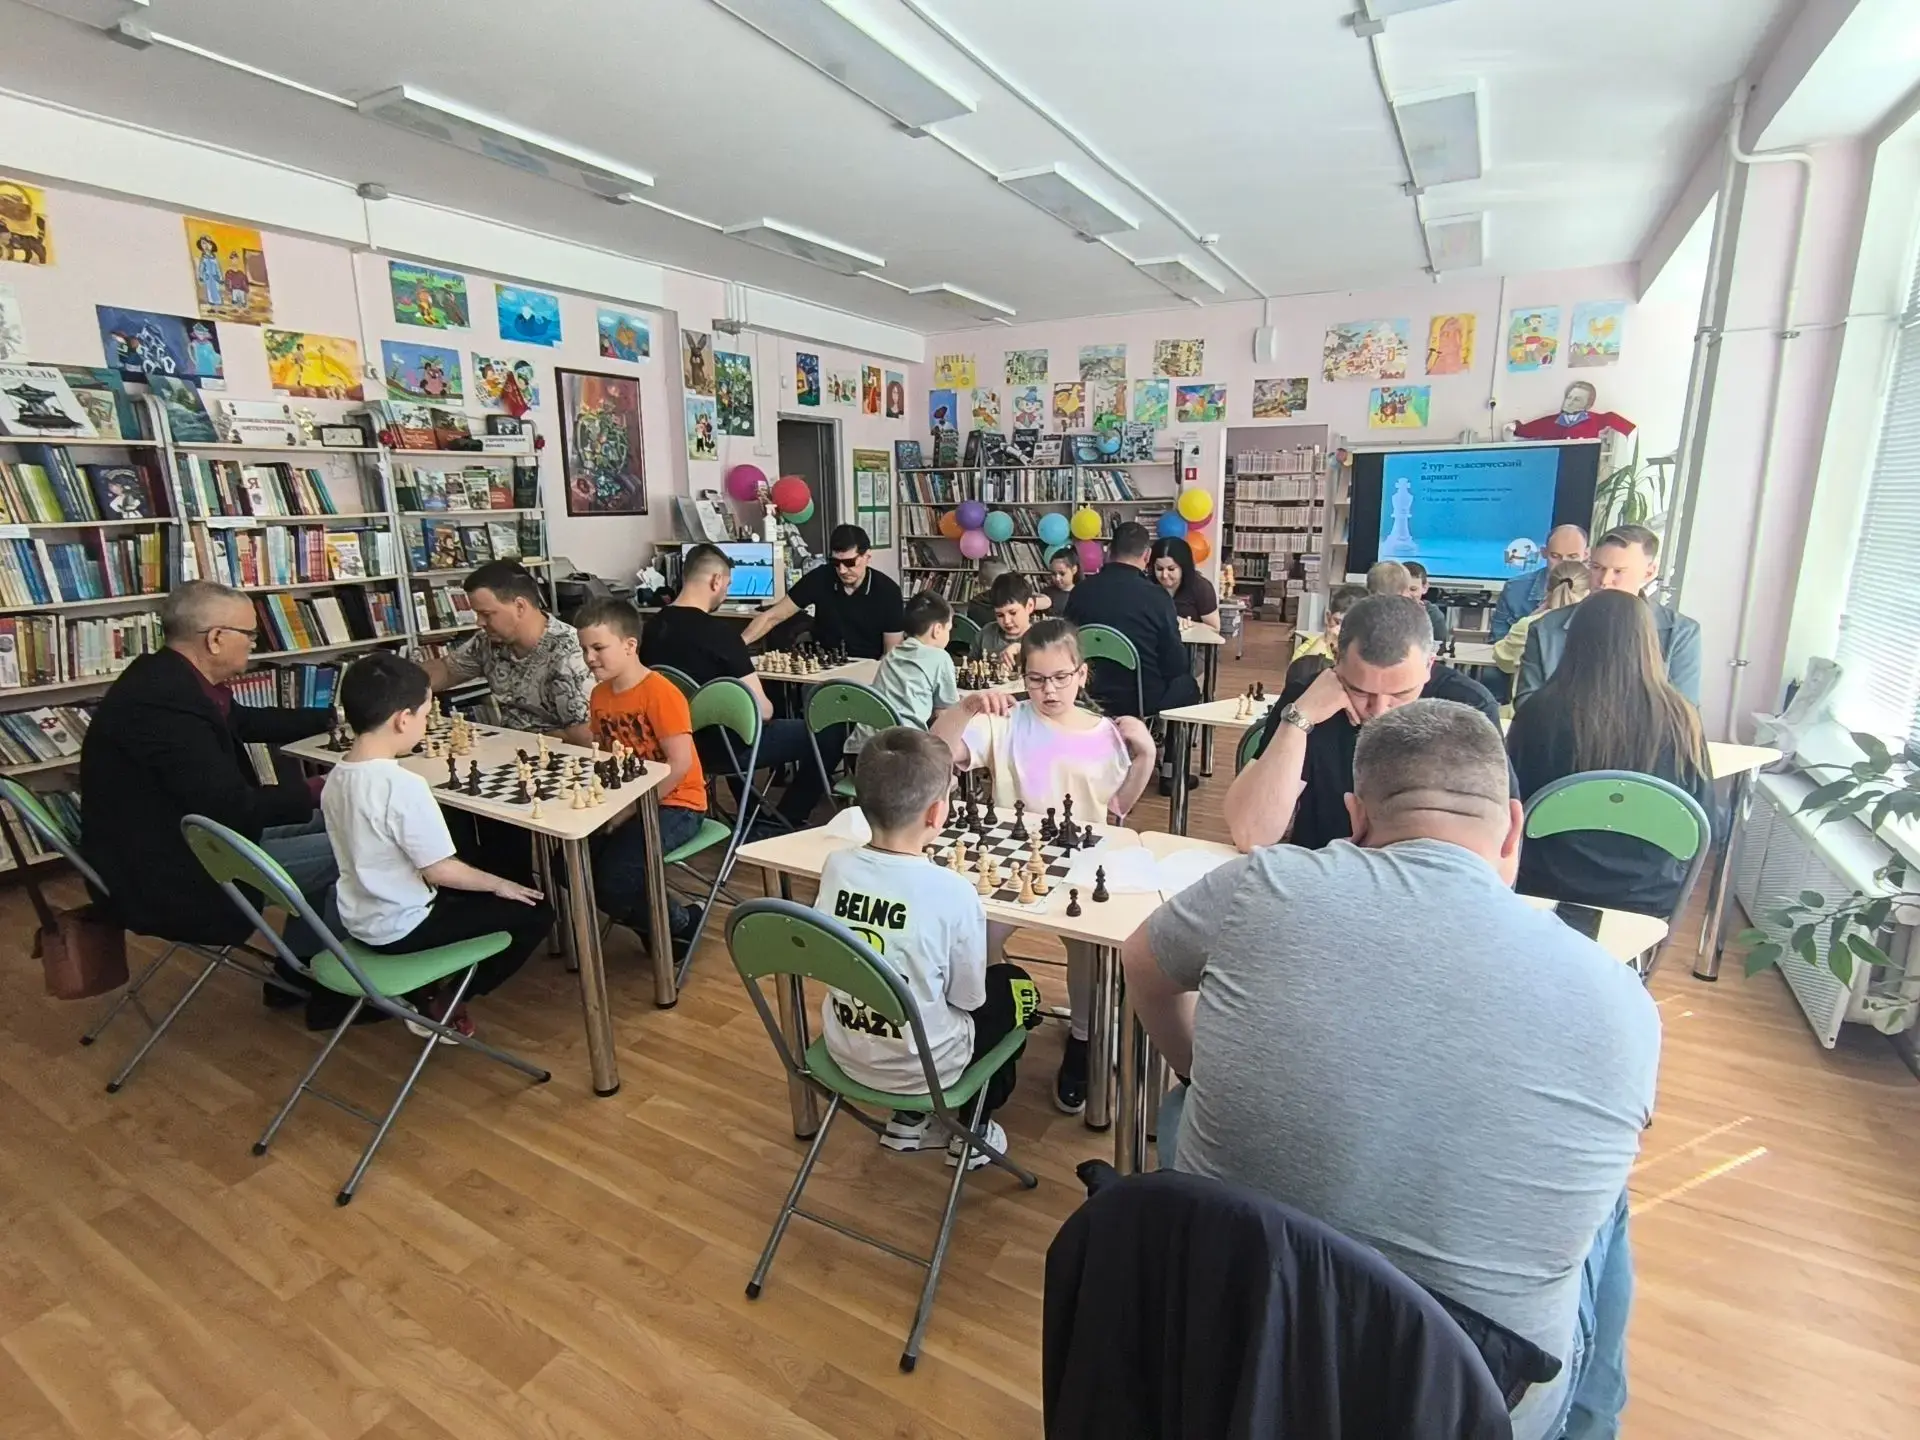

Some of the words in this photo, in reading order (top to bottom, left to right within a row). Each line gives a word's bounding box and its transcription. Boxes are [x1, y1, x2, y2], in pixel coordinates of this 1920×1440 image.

[1429, 463, 1445, 472] тур
[1454, 459, 1522, 469] классический
[1421, 474, 1459, 483] вариант
[835, 890, 907, 929] BEING
